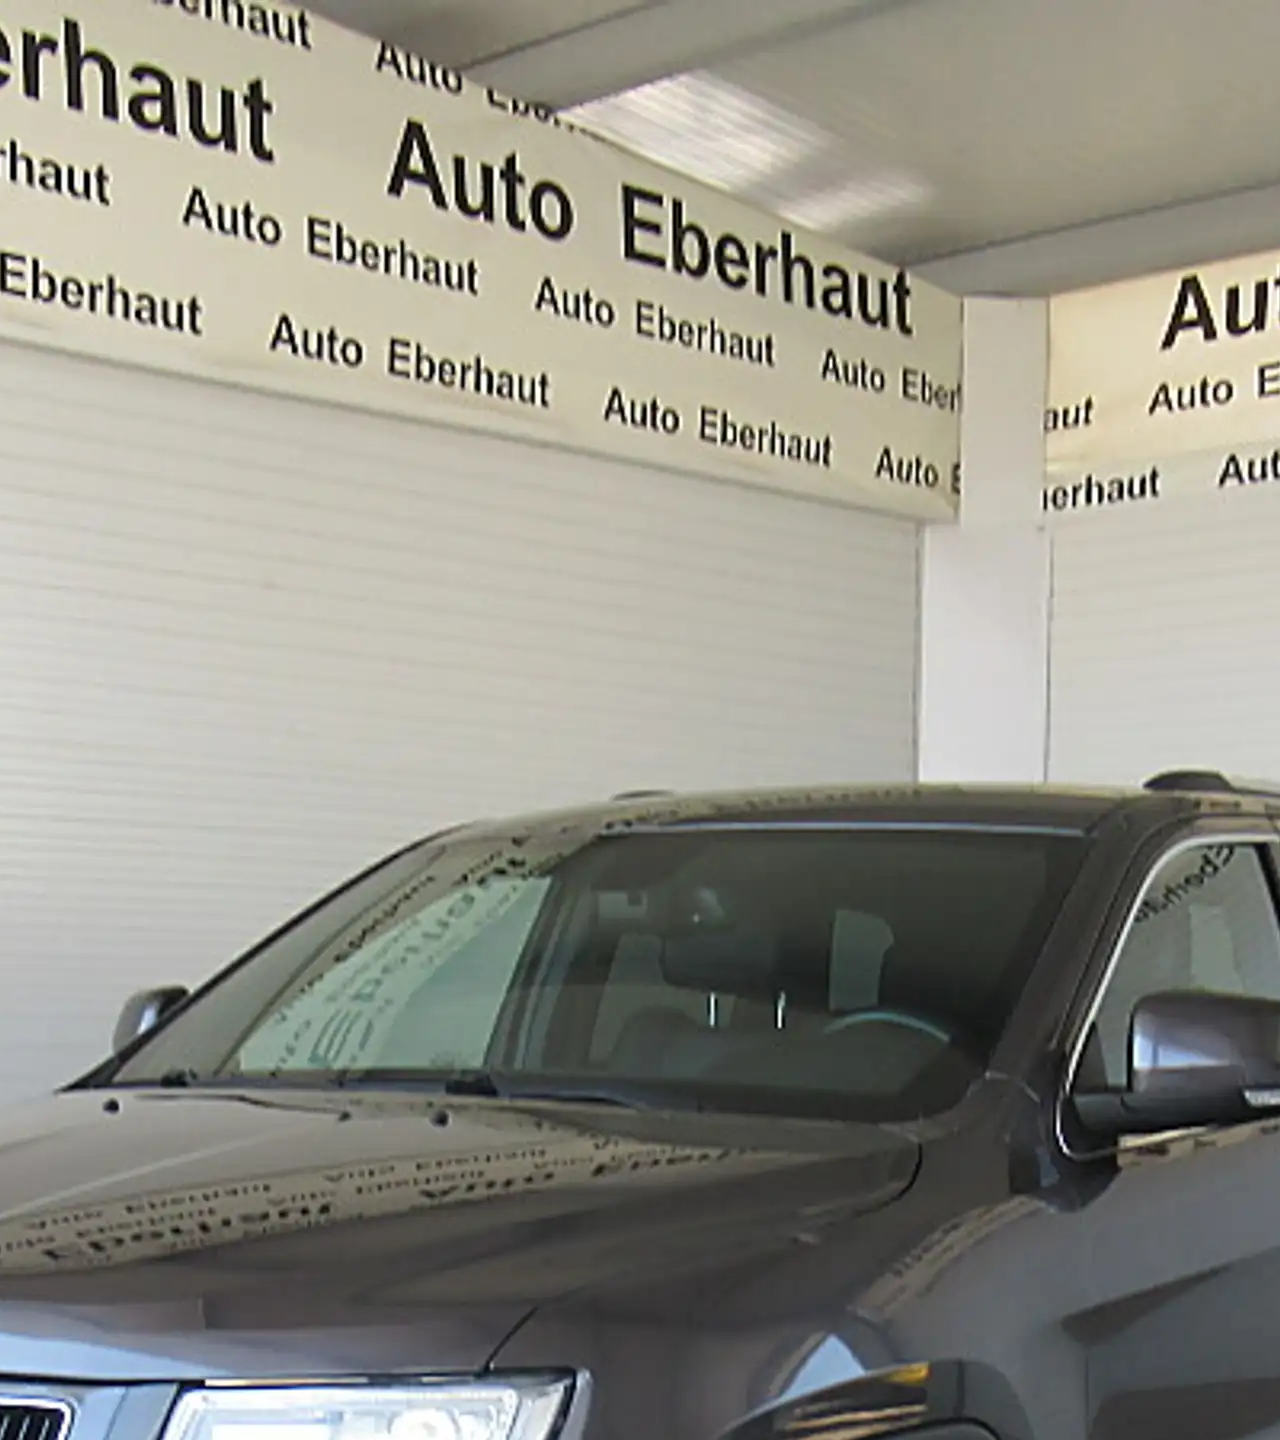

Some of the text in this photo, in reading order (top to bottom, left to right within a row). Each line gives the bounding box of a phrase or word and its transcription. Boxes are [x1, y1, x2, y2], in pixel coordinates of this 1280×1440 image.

[181, 187, 480, 296] Auto Eberhaut
[386, 117, 913, 336] Auto Eberhaut
[268, 314, 550, 408] Auto Eberhaut
[535, 276, 775, 367] Auto Eberhaut
[821, 348, 886, 394] Auto
[1148, 374, 1235, 416] Auto
[603, 387, 832, 470] Auto Eberhaut
[875, 445, 939, 489] Auto
[1042, 465, 1160, 511] erhaut
